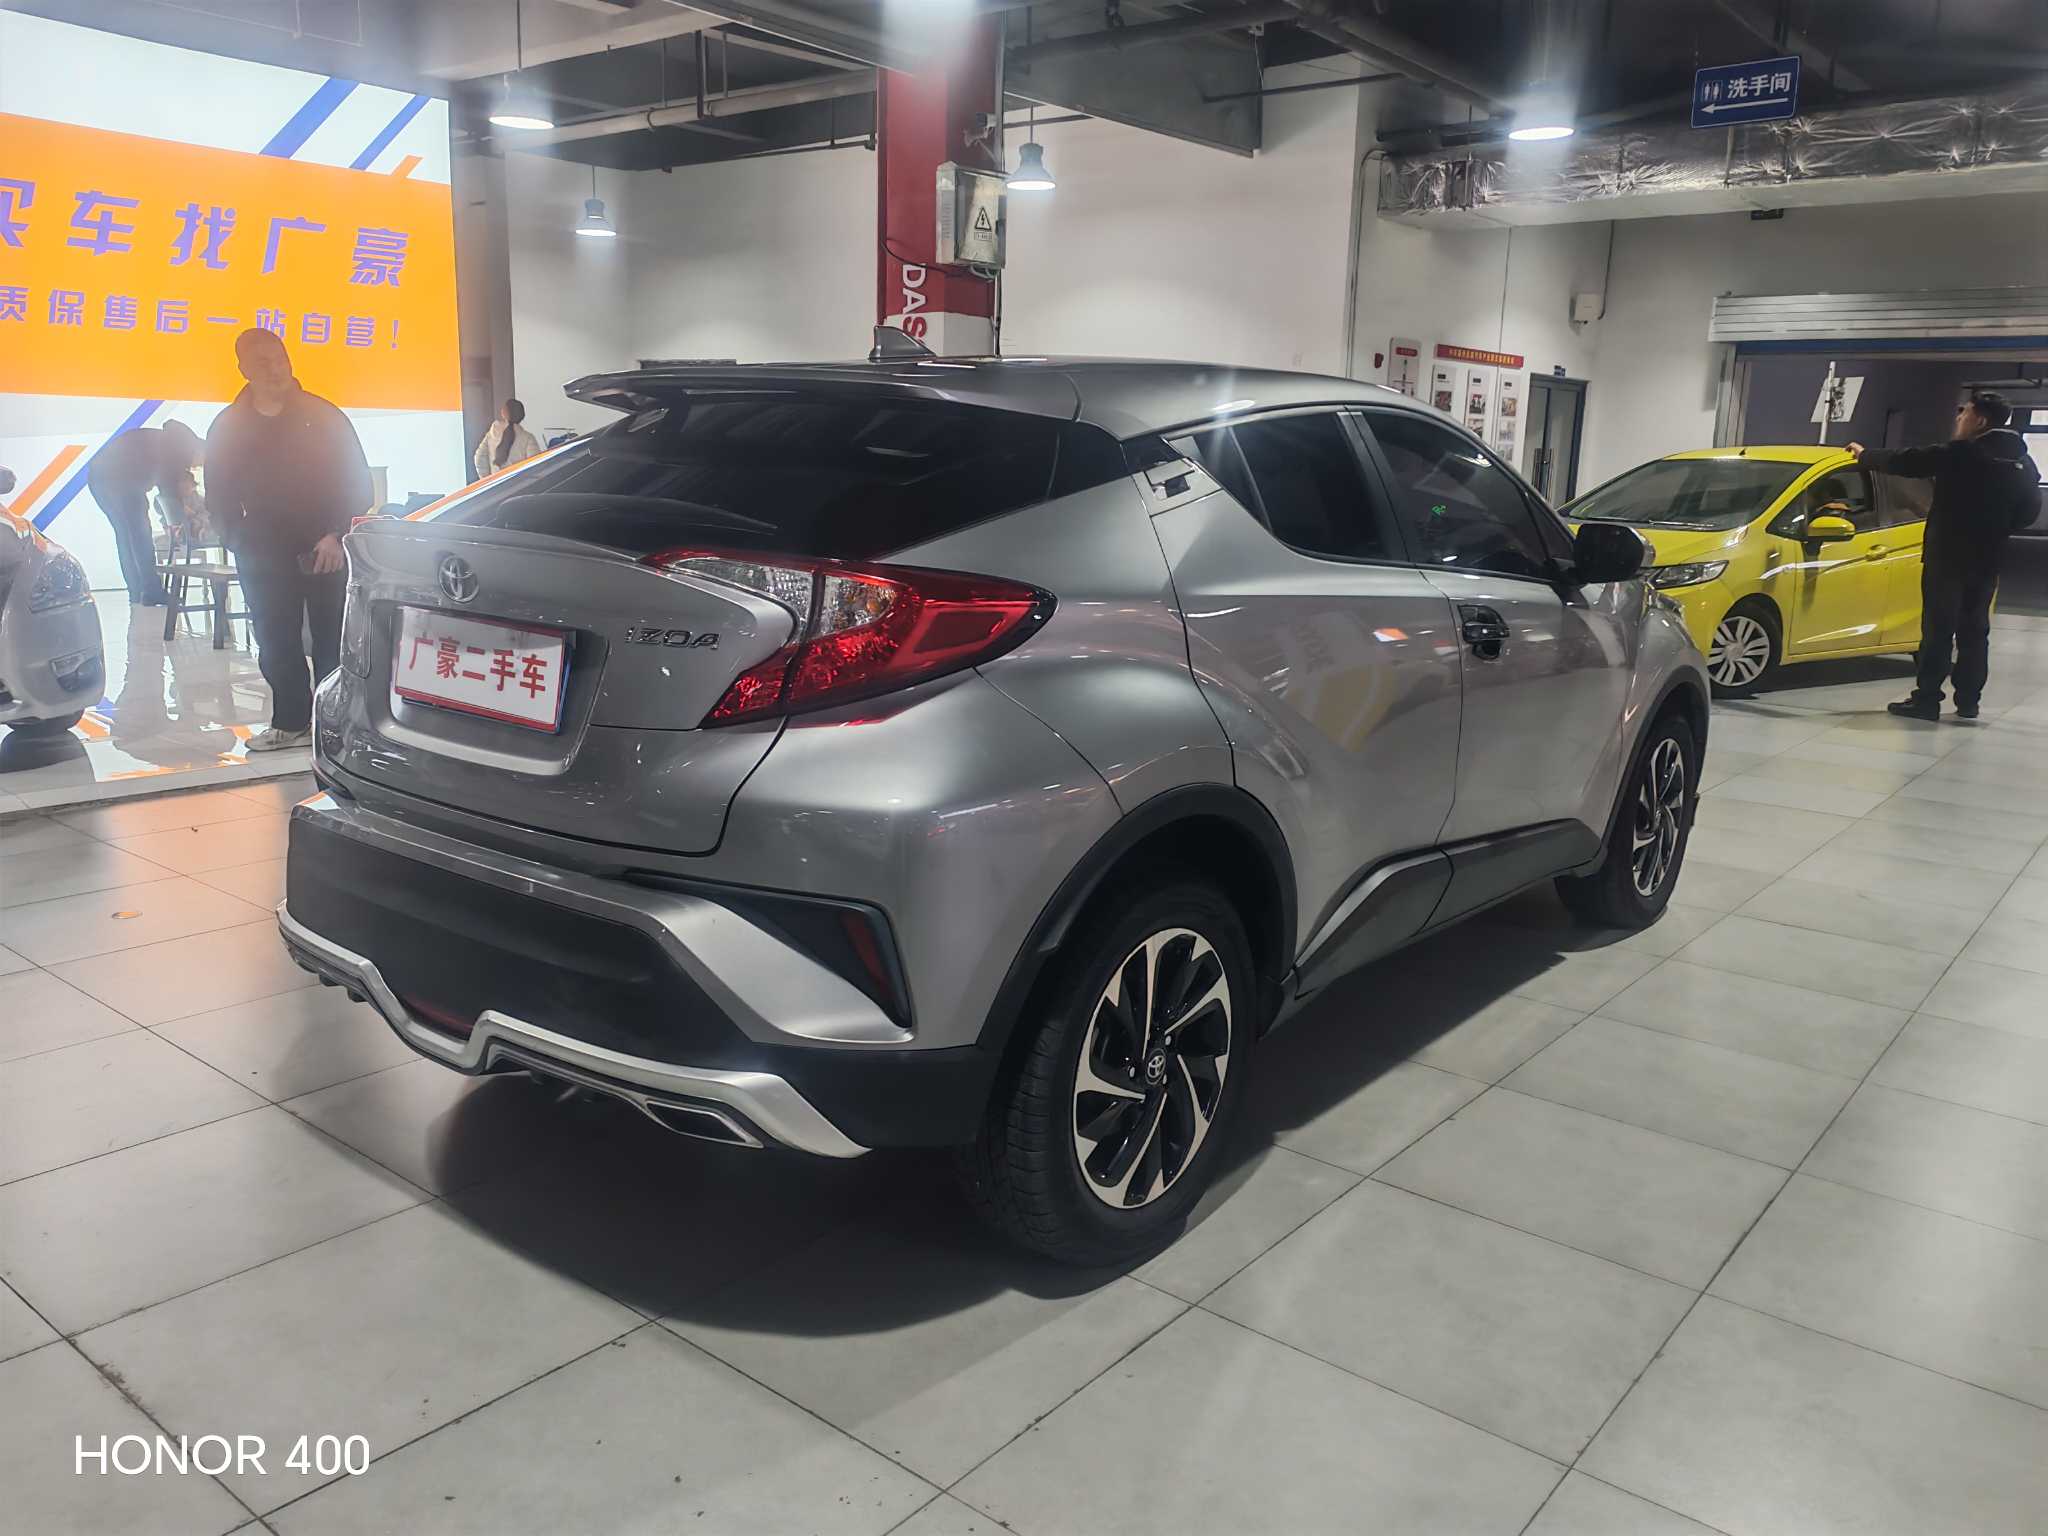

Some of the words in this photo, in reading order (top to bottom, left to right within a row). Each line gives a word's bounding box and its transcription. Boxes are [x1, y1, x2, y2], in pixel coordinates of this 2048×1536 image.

[1727, 72, 1792, 99] 洗手间
[902, 263, 928, 344] DAS
[624, 627, 720, 650] IZOA
[409, 631, 547, 699] 广豪二手车
